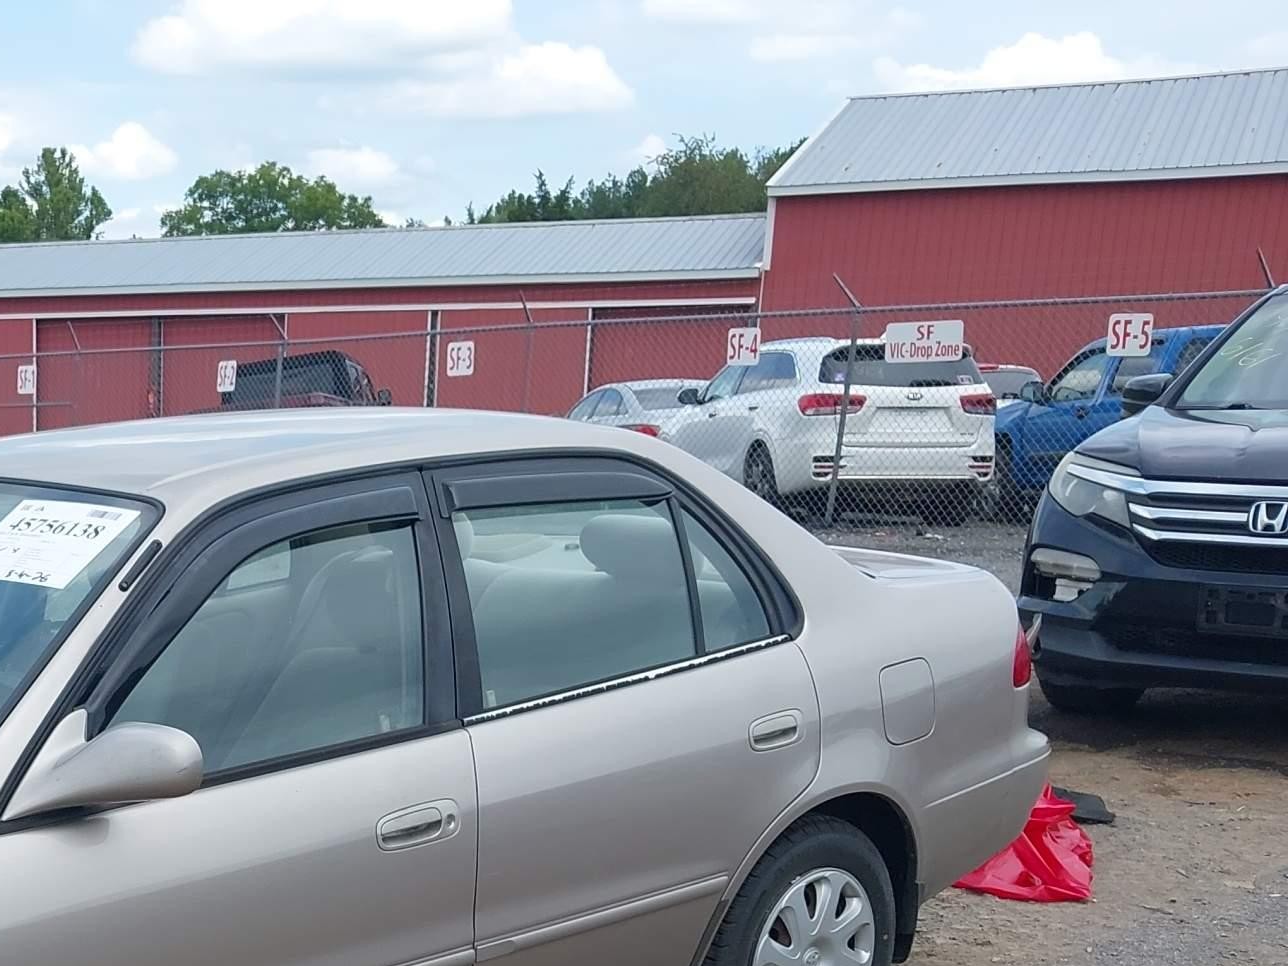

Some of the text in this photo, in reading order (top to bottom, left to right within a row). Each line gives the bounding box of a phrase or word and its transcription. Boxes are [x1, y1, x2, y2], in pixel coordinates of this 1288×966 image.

[916, 324, 935, 341] SF
[1110, 319, 1151, 350] SF-5
[449, 346, 473, 371] SF-3
[729, 333, 758, 360] SF-4
[889, 340, 960, 360] VIC-Drop Zone
[19, 369, 35, 391] SF-1
[218, 364, 235, 388] SF-2
[9, 516, 107, 540] 45756138
